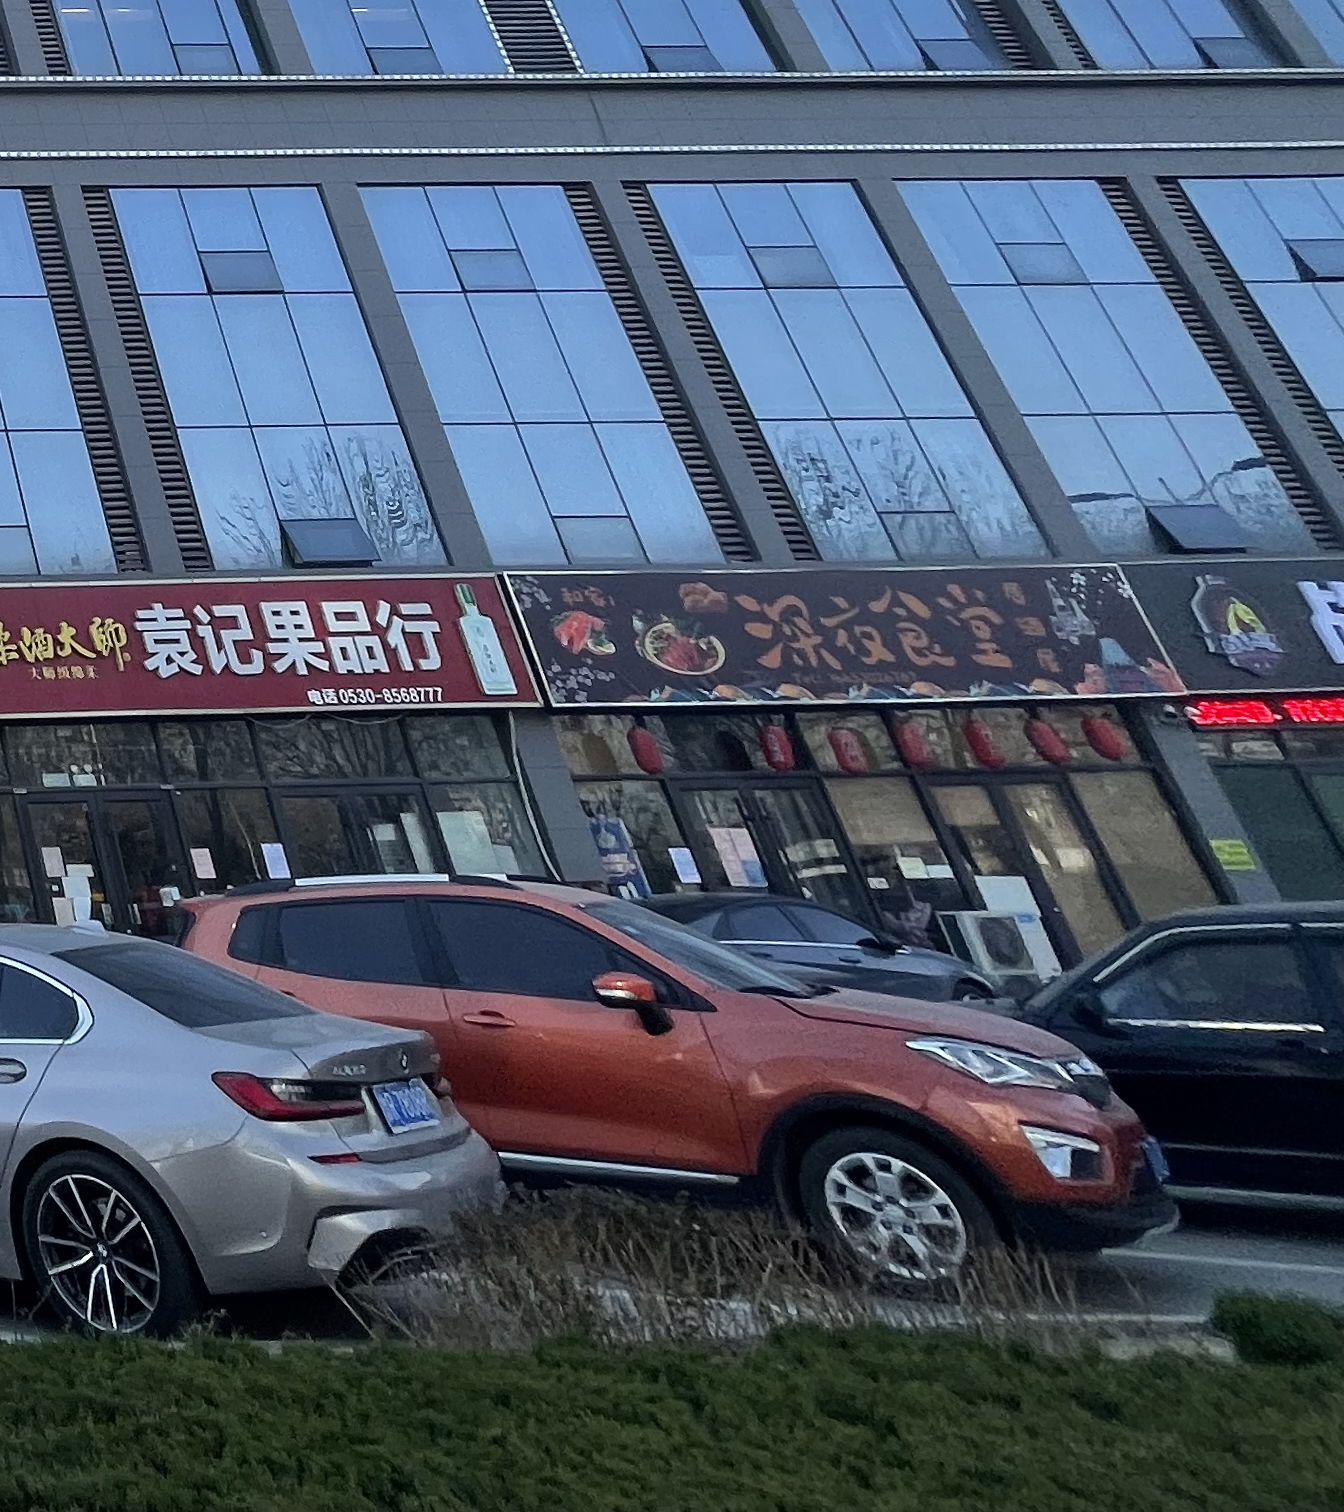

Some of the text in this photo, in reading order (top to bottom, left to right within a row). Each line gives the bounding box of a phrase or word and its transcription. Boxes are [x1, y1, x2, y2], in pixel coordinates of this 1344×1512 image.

[134, 599, 441, 678] 袁记果品行
